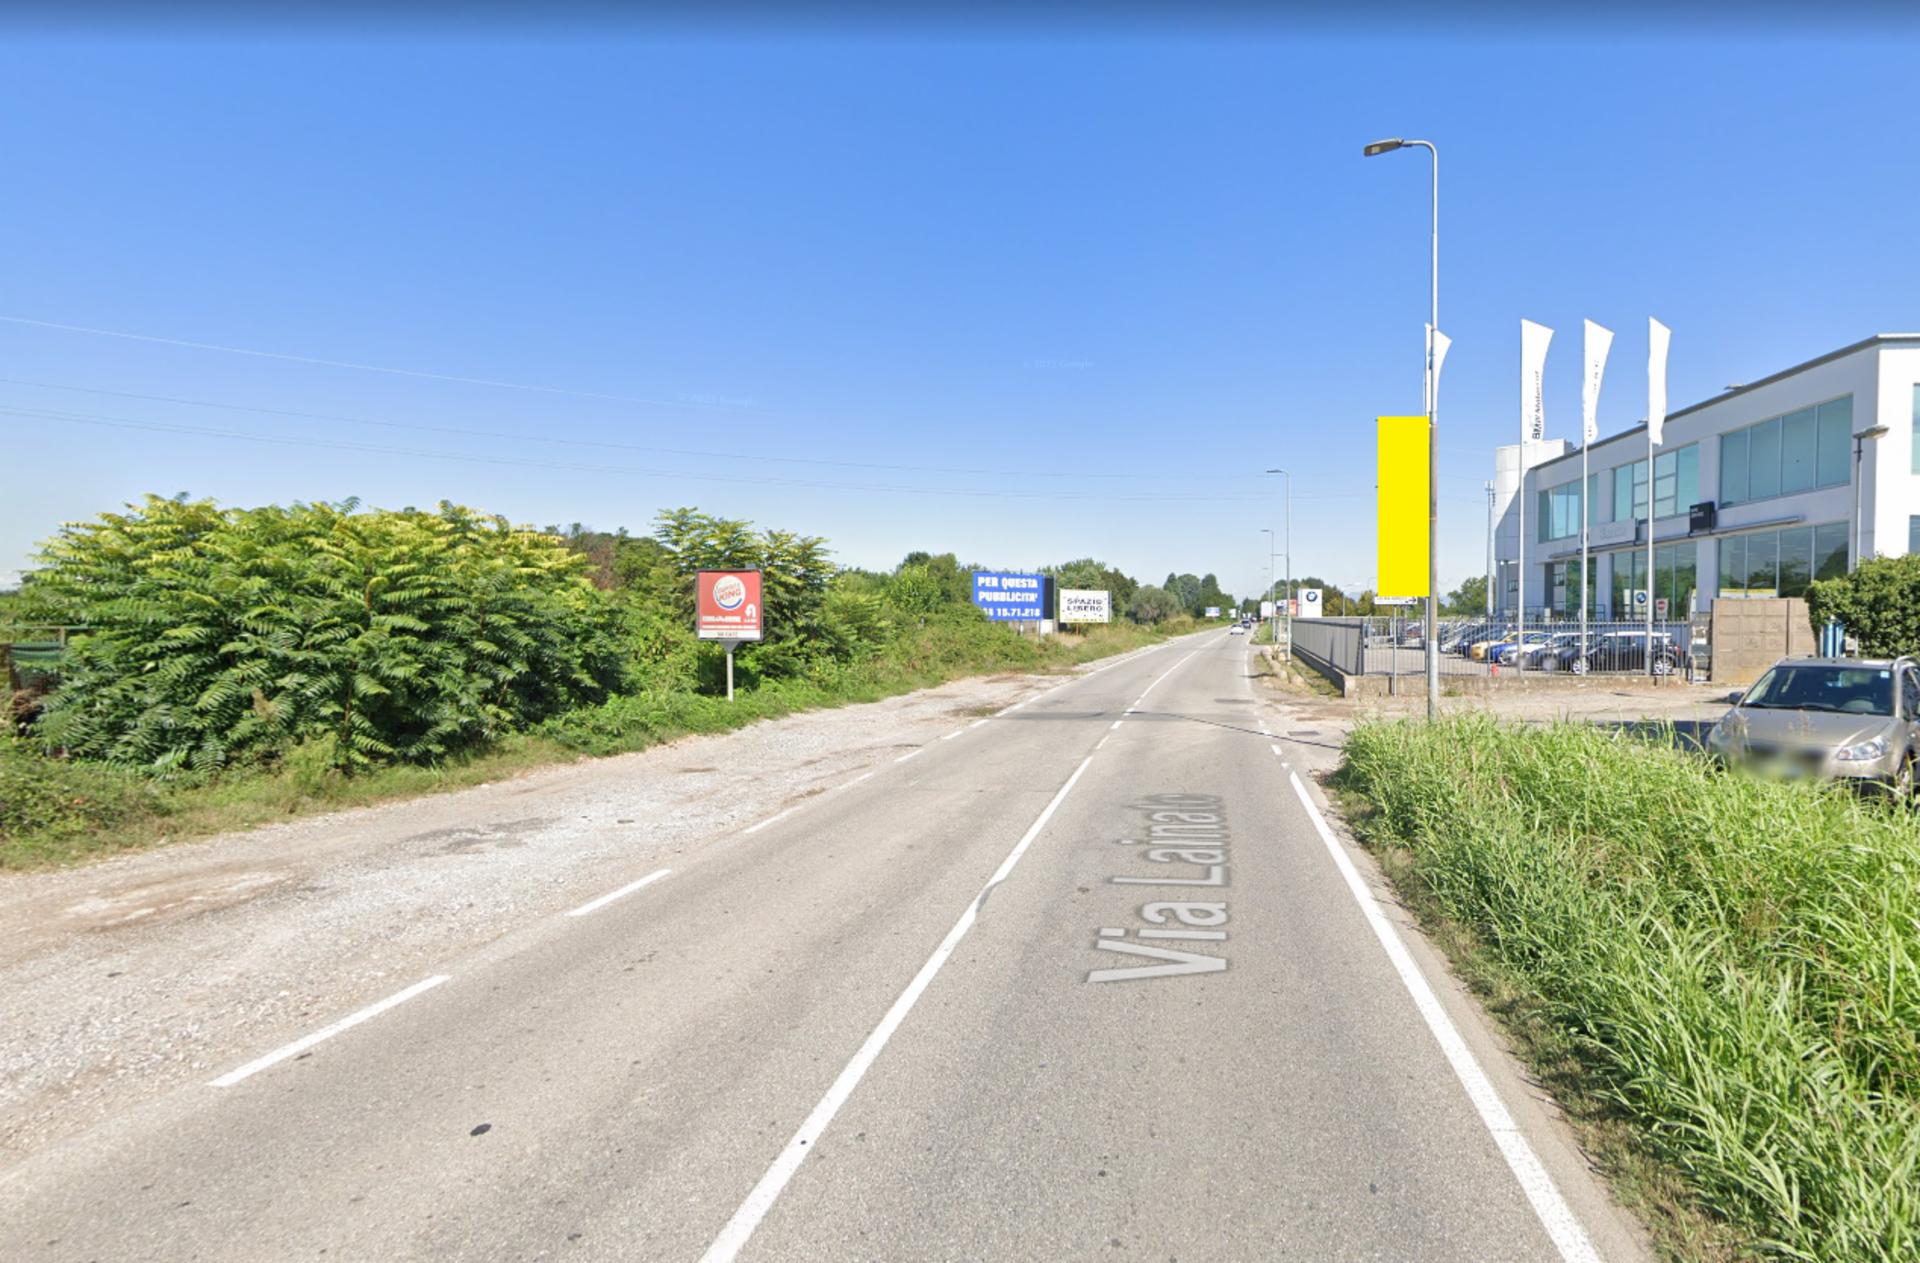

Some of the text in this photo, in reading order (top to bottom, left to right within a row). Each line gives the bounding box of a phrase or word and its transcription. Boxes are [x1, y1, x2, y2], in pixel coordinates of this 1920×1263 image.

[977, 576, 1039, 590] PER QUESTA
[1066, 605, 1104, 613] LIBERO
